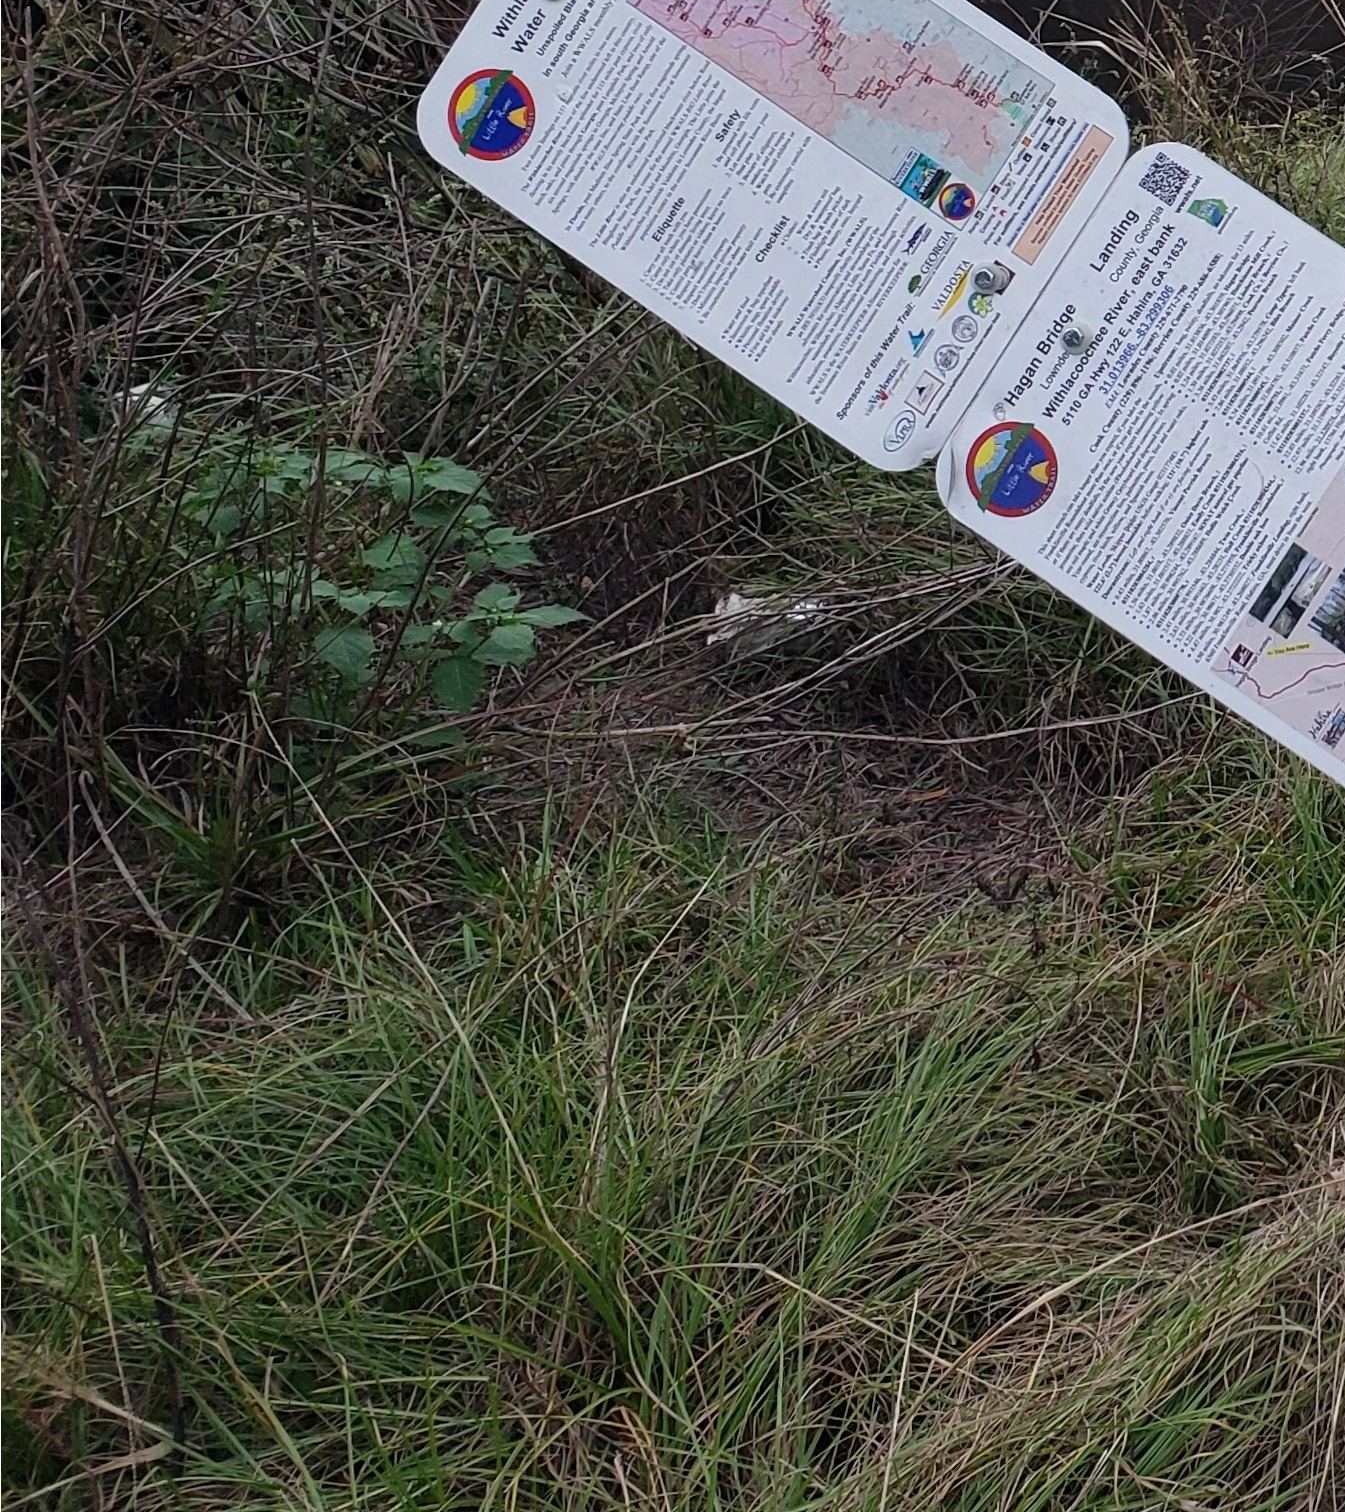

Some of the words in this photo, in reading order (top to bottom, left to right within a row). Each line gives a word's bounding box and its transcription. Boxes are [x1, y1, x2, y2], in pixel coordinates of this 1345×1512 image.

[509, 7, 547, 53] Water
[534, 11, 568, 57] Unspoiled
[541, 66, 553, 78] in
[548, 41, 569, 68] south
[563, 7, 591, 42] Georgia
[571, 25, 596, 57] WWALS
[559, 62, 575, 79] Join
[569, 56, 578, 64] a
[482, 118, 500, 140] Little
[495, 96, 513, 118] River
[713, 107, 742, 143] Safety
[1173, 173, 1204, 214] wwals.net
[650, 196, 686, 243] Etiquette
[753, 214, 791, 263] Checklist
[918, 228, 953, 275] GEORGIA
[1161, 236, 1189, 270] 31632
[930, 257, 970, 312] VALDOSTA
[1038, 350, 1070, 391] Lownde
[1108, 246, 1141, 283] County,
[1133, 204, 1165, 245] Georgia
[1150, 269, 1168, 287] GA
[784, 311, 806, 338] WWALS
[1002, 356, 1043, 407] Hagan
[1034, 303, 1077, 356] Bridge
[1087, 208, 1140, 273] Landing
[1040, 325, 1109, 419] Withlacoochee
[1101, 287, 1136, 326] River,
[1130, 255, 1154, 286] east
[1146, 222, 1176, 257] bank
[1124, 289, 1157, 326] Hahira,
[1097, 340, 1142, 396] 31.013966,
[1134, 283, 1176, 344] -83.299306
[1105, 336, 1124, 357] 122
[1116, 325, 1133, 338] E,
[1116, 355, 1142, 389] Lowndes
[1137, 329, 1160, 357] County
[1153, 282, 1189, 332] 229-671-2790
[835, 378, 867, 421] Sponsors
[862, 364, 873, 380] of
[868, 350, 884, 369] this
[878, 322, 901, 351] Water
[895, 300, 916, 325] Trail:
[1088, 356, 1111, 383] Hwy
[1088, 433, 1106, 454] Cook
[1100, 406, 1123, 434] County
[1117, 387, 1136, 408] (229)
[1151, 326, 1175, 355] Berrien
[1169, 299, 1192, 327] County
[1152, 344, 1179, 379] Upstream:
[1060, 398, 1082, 427] 5110
[1077, 381, 1096, 400] GA
[1001, 472, 1021, 496] Little
[1015, 450, 1034, 473] River
[1100, 557, 1132, 601] Downstream:
[1245, 655, 1259, 672] Bridge
[1256, 635, 1272, 656] Landing
